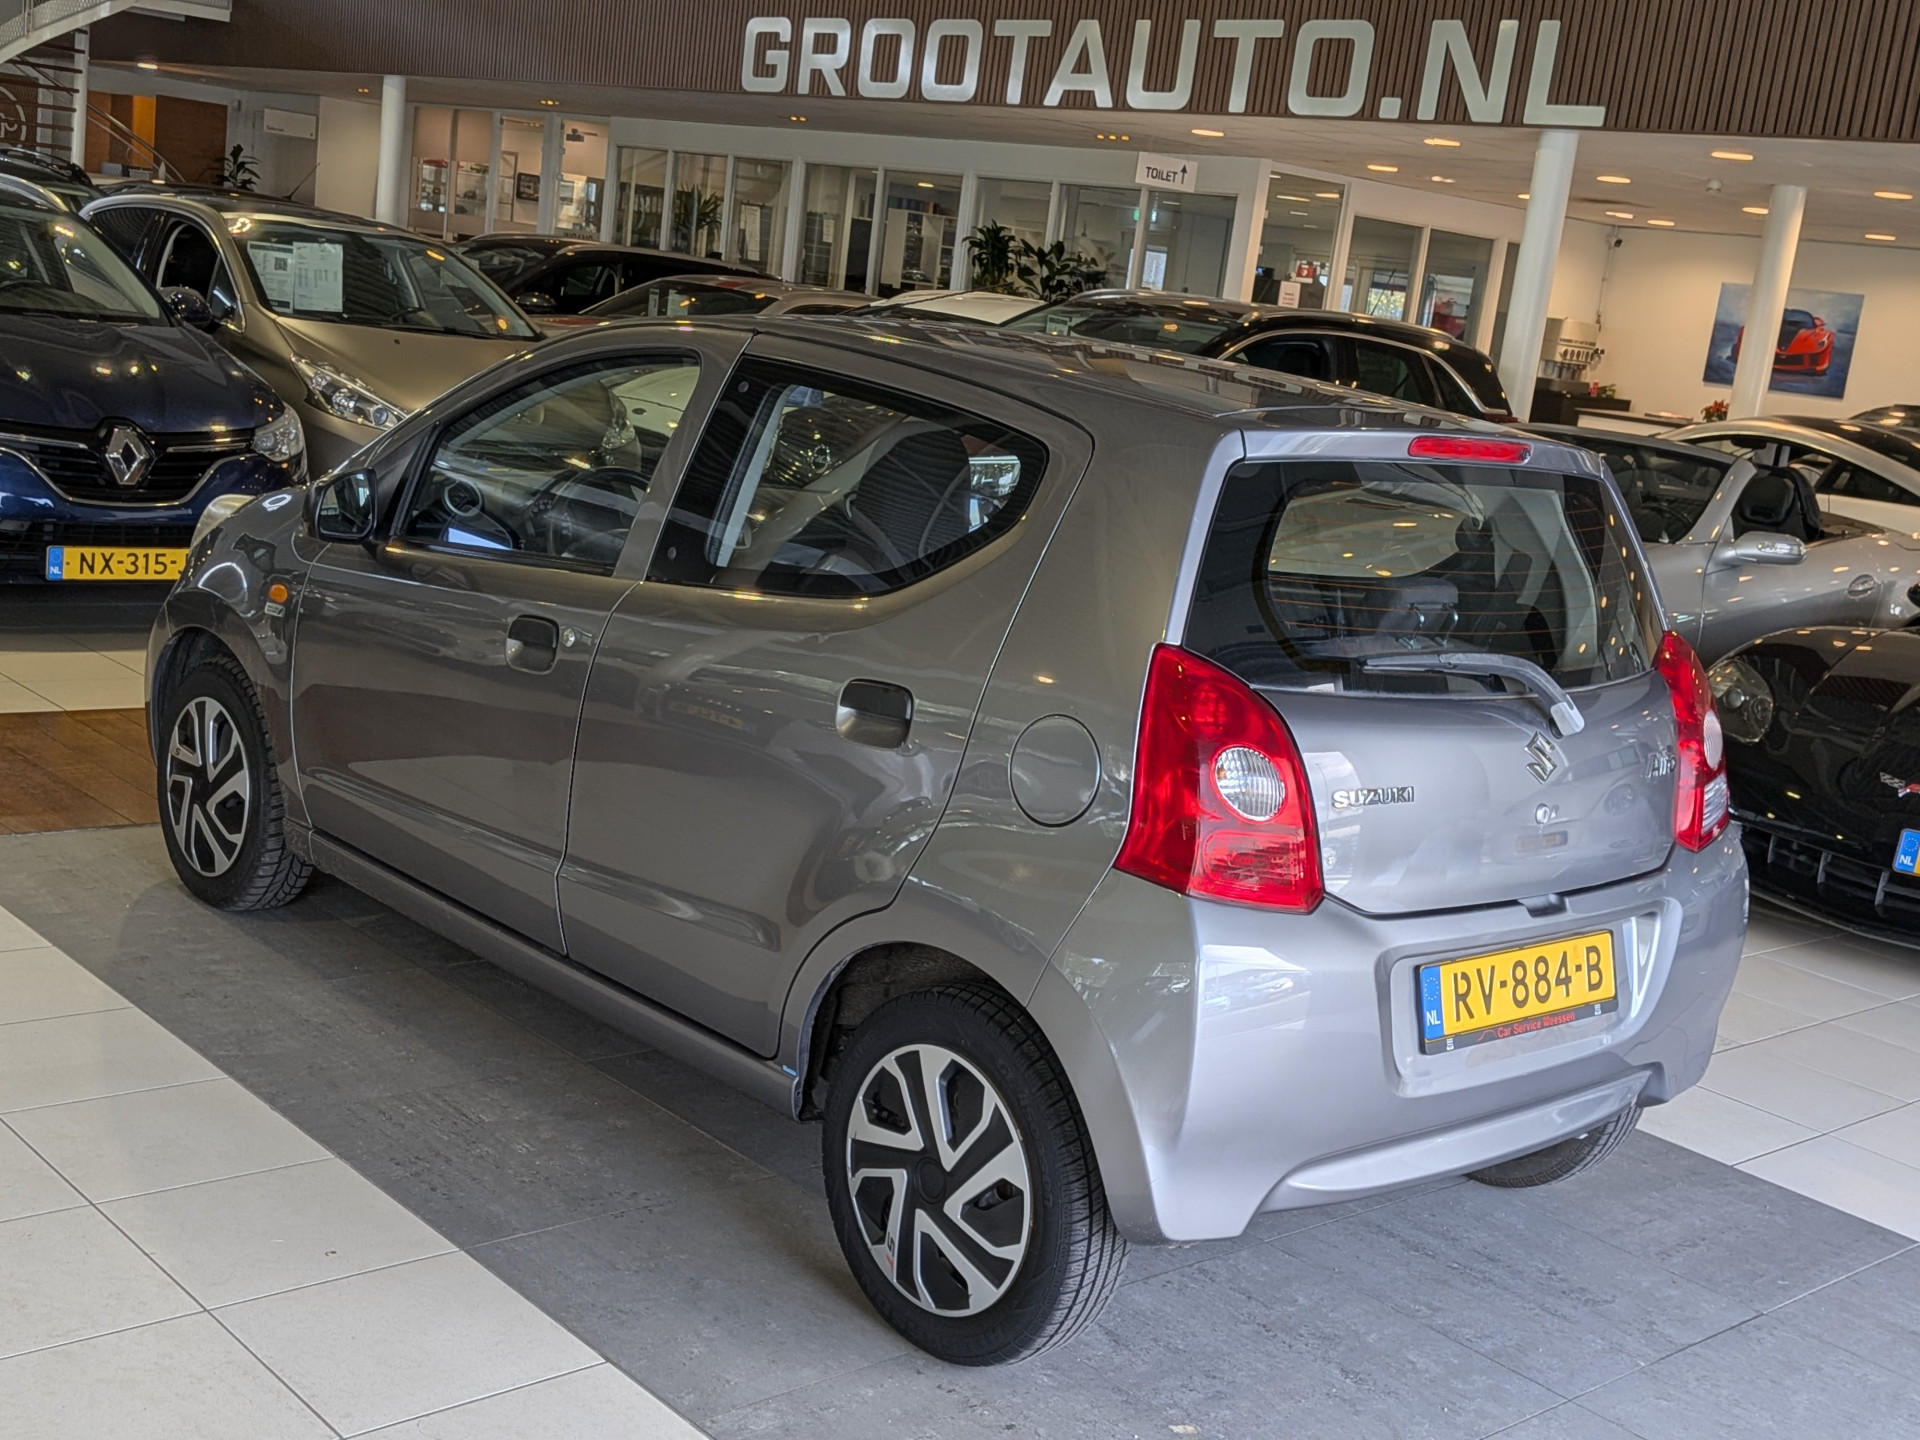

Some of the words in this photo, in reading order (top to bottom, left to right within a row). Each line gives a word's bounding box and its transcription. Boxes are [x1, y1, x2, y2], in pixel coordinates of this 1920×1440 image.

[741, 16, 1606, 127] GROOTAUTO.NL
[1145, 166, 1178, 183] TOILET
[50, 566, 61, 574] NL
[1331, 786, 1415, 809] SUZUKI
[1899, 855, 1914, 866] NL
[1453, 945, 1604, 1023] RV-884-B
[1426, 1010, 1441, 1027] NL
[1497, 1026, 1512, 1038] Car
[1513, 1020, 1542, 1035] Service
